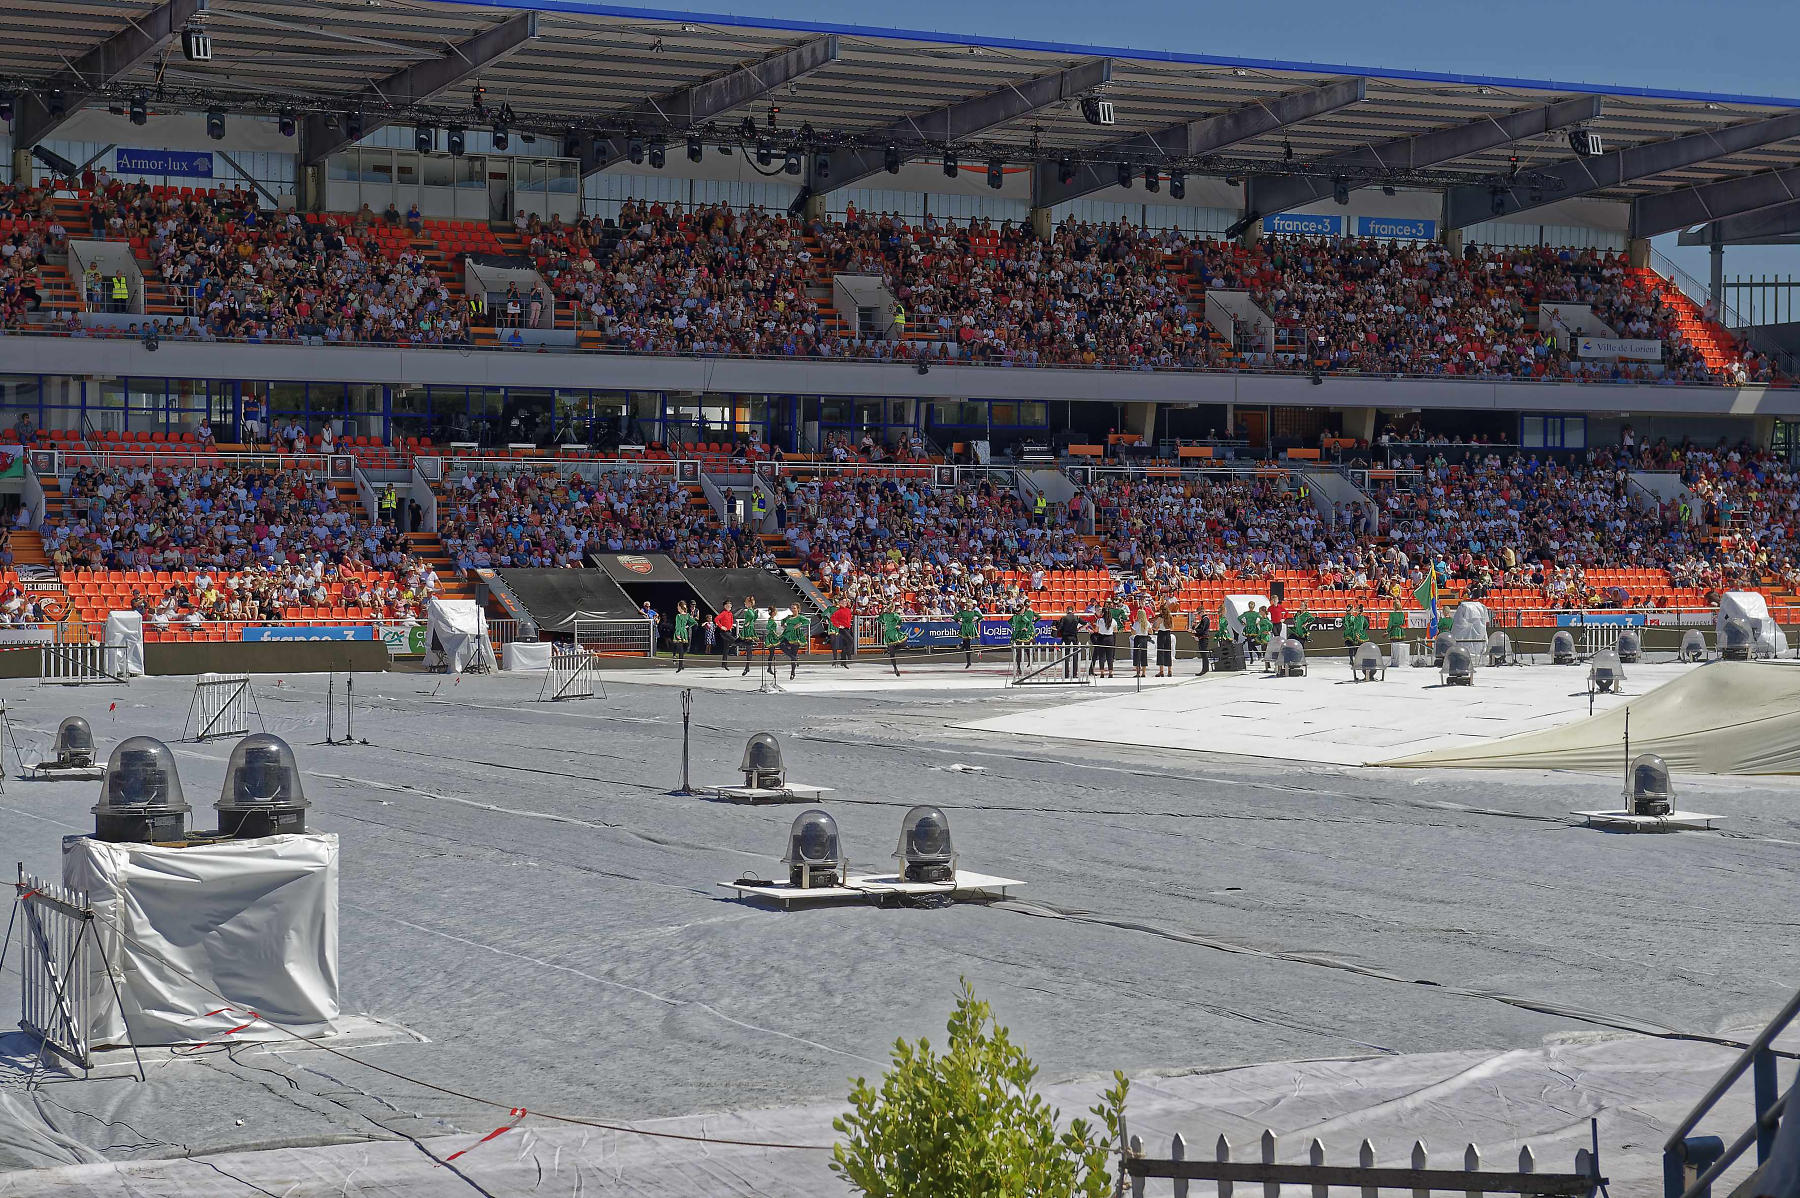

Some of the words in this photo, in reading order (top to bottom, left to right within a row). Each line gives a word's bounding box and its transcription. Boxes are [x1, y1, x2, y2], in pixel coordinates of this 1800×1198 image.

[1597, 343, 1616, 352] Ville
[1618, 344, 1628, 352] de
[1630, 344, 1656, 353] Lorient
[1410, 618, 1427, 627] Vill
